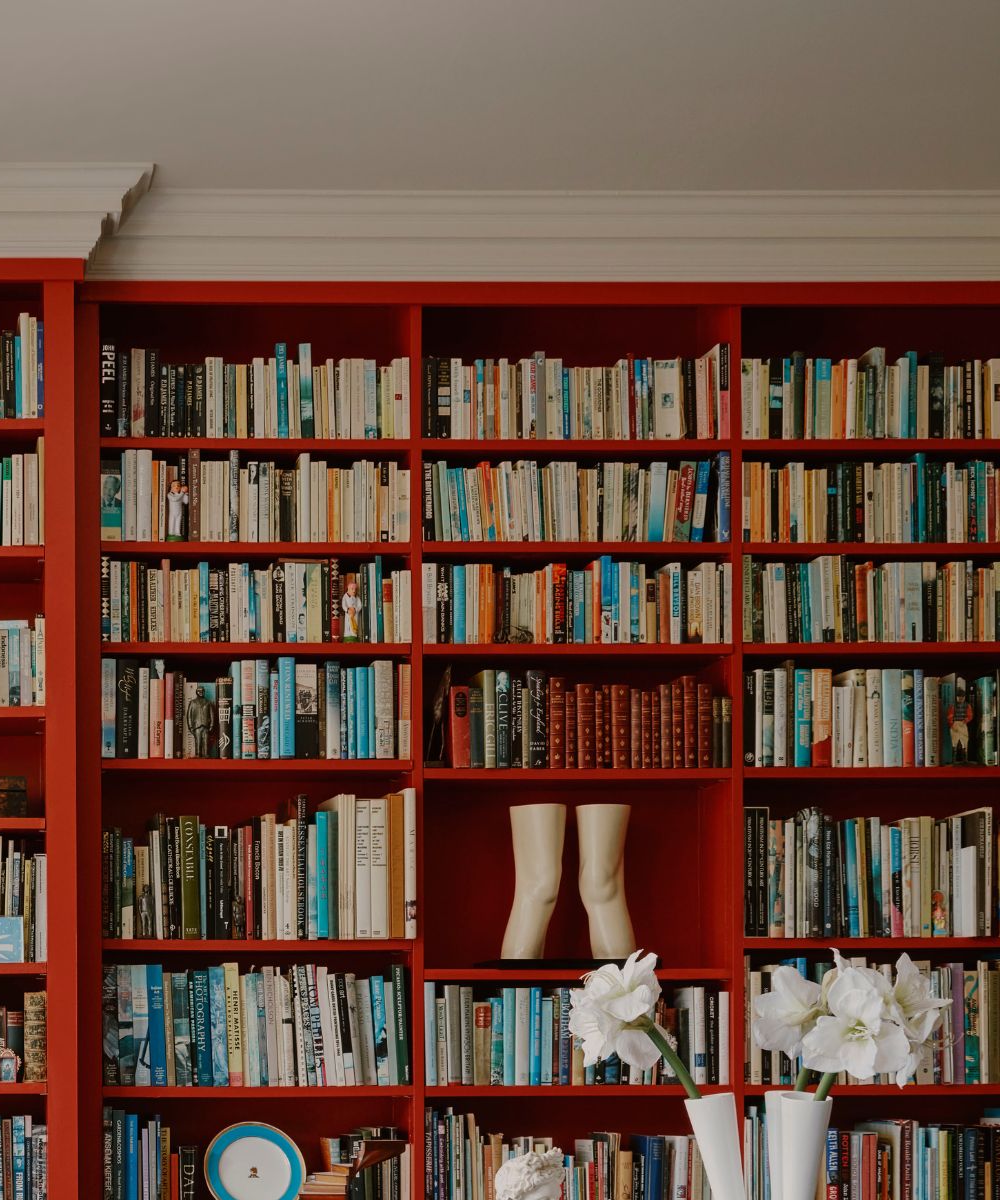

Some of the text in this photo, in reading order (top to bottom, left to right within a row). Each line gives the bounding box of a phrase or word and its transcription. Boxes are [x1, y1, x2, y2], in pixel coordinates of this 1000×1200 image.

[102, 352, 115, 384] PEEL
[499, 693, 508, 730] CLIVE
[530, 708, 545, 734] England
[485, 703, 496, 763] ERIC GILL
[889, 718, 898, 750] INDIA
[185, 821, 194, 882] CONSTABLE
[308, 984, 318, 1007] TOM
[195, 975, 206, 1051] PHOTOGRAPHY
[828, 1131, 838, 1150] KEITH
[828, 1151, 838, 1170] ALLEN
